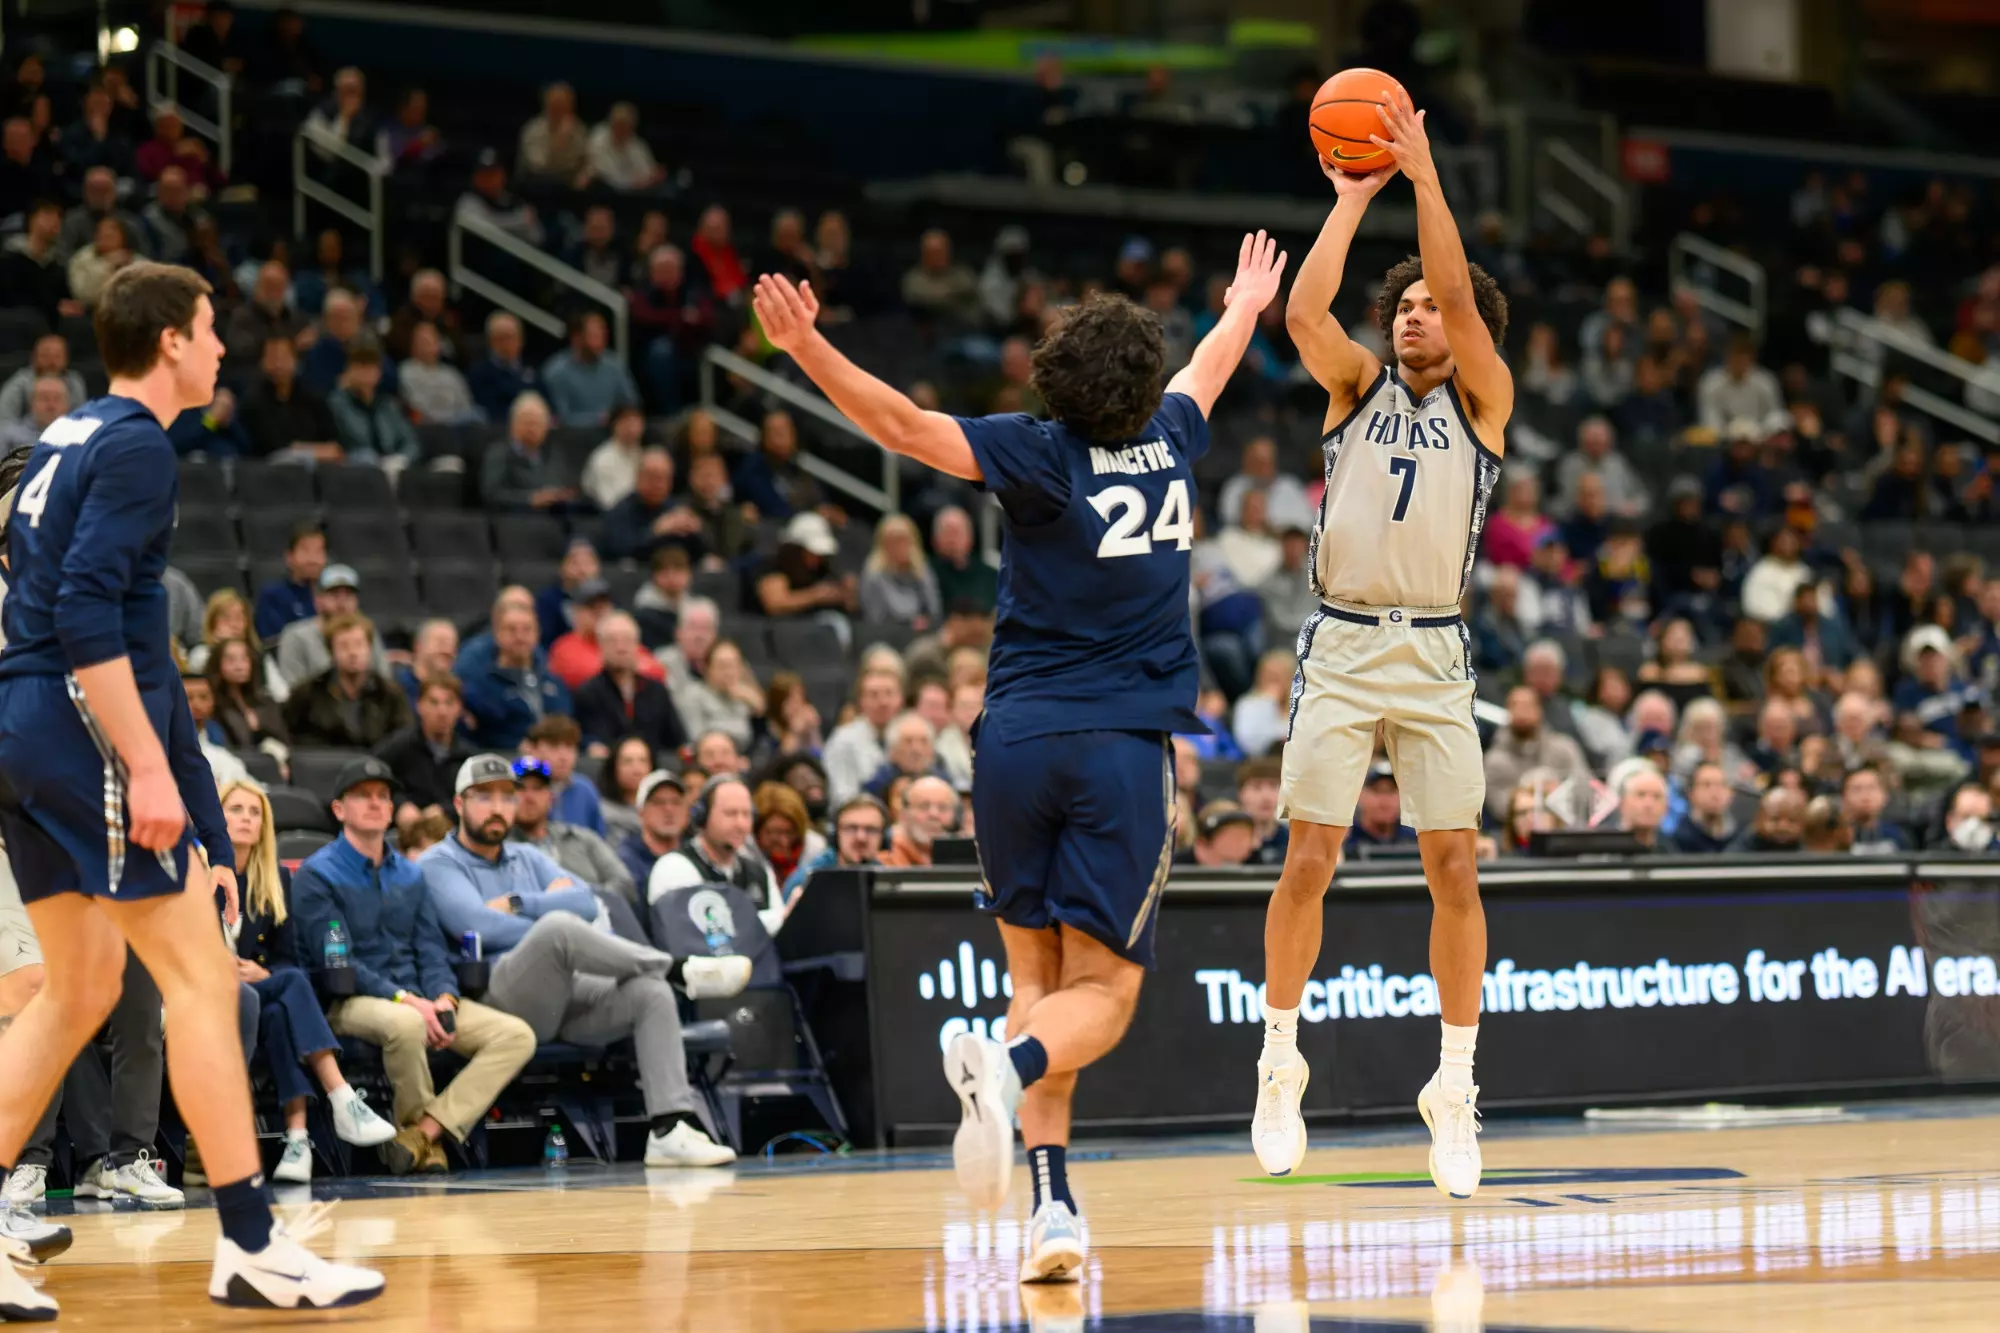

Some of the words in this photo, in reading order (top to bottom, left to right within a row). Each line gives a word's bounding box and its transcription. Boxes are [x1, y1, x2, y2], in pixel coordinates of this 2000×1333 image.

[1364, 409, 1450, 451] HOAS
[16, 452, 62, 528] 4
[1085, 479, 1194, 558] 24
[1388, 455, 1417, 523] 7
[1388, 609, 1403, 623] G
[1299, 963, 1441, 1023] critica
[1480, 958, 1740, 1013] nfrastructure
[1744, 949, 1806, 1002] for
[1810, 947, 1879, 1000] the
[1885, 944, 1928, 998] AI
